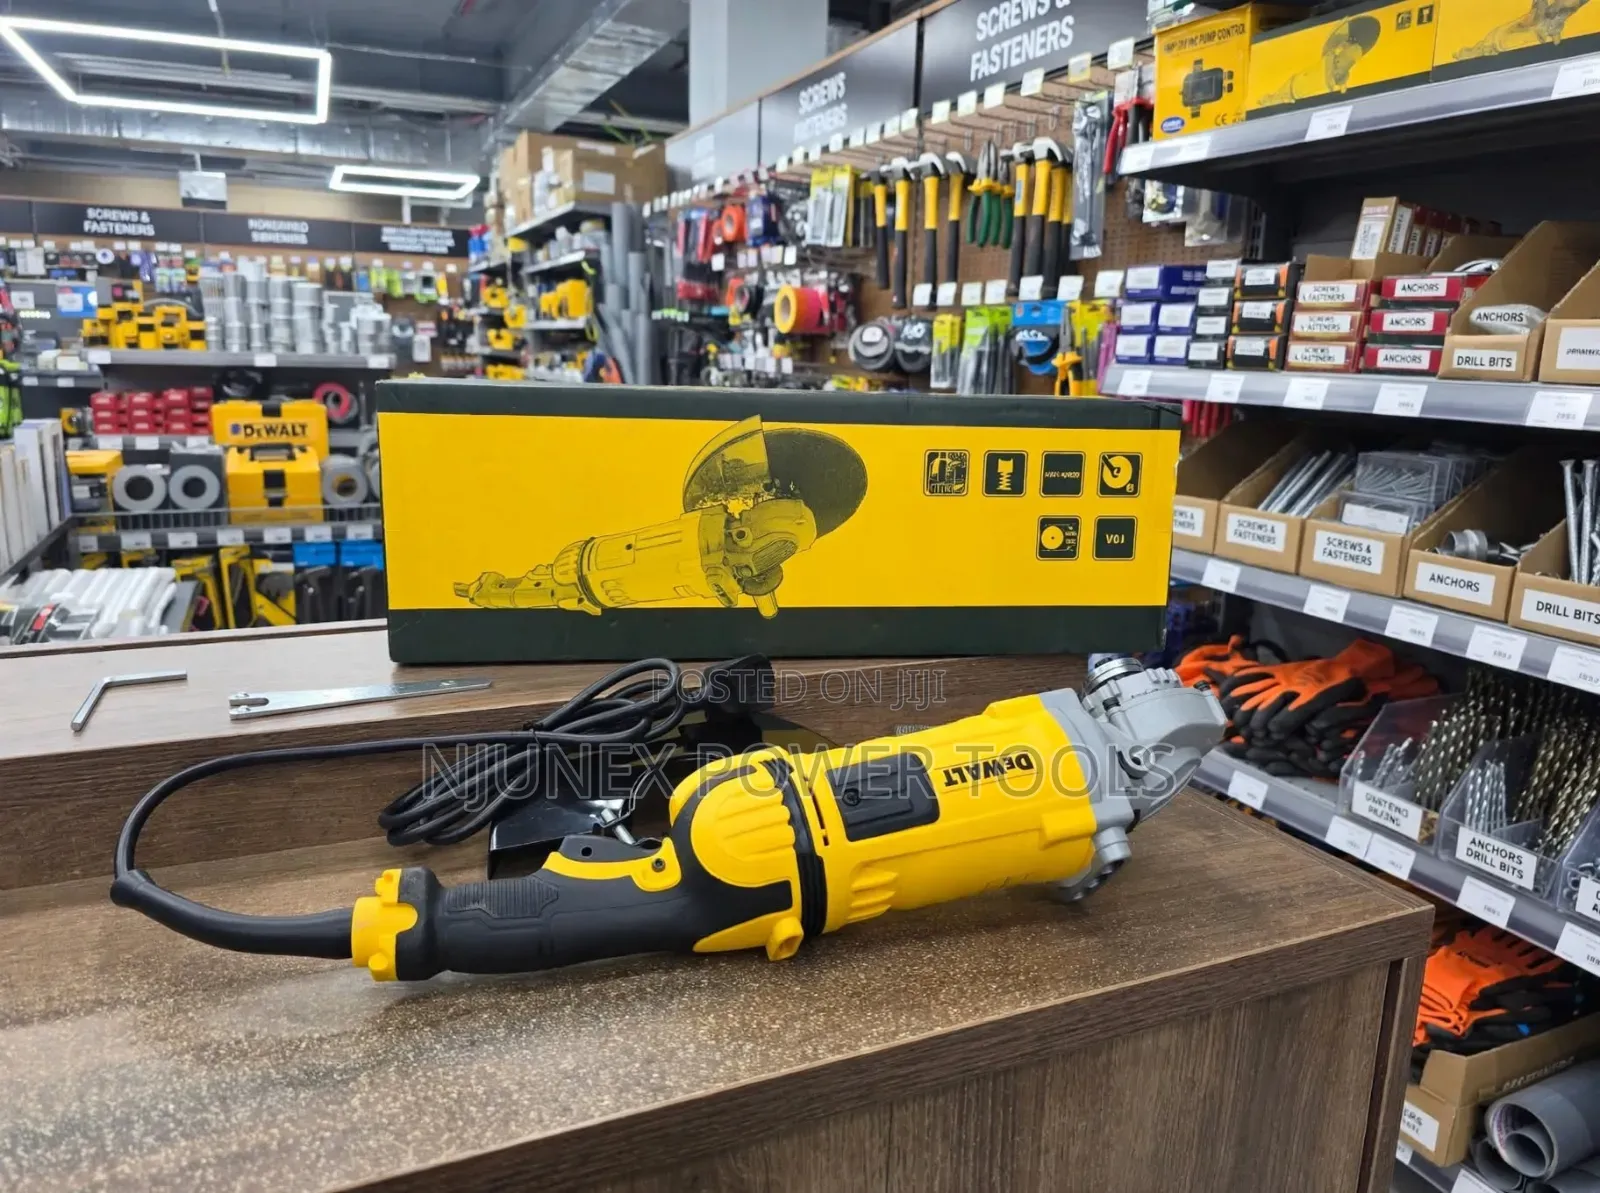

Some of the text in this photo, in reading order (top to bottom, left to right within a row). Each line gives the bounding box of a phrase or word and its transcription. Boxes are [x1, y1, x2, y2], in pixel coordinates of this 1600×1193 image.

[970, 15, 1075, 82] FASTENERS
[799, 71, 846, 115] SCREWS
[86, 207, 151, 223] SCREWS &
[83, 220, 156, 237] FASTENERS
[1400, 282, 1440, 293] ANCHORS
[1388, 316, 1427, 327] ANCHORS
[1475, 311, 1524, 323] ANCHORS
[1382, 354, 1423, 365] ANCHORS
[1456, 355, 1513, 368] DRILL BITS
[1237, 519, 1270, 533] SCREWS
[1233, 530, 1277, 545] FASTENERS
[1326, 536, 1372, 554] SCREWS &
[1322, 547, 1373, 566] FASTENERS
[1429, 572, 1480, 593] ANCHORS
[1535, 600, 1600, 625] DRILL BITS
[1469, 836, 1524, 865] ANCHORS
[1465, 847, 1525, 880] DRILL BITS
